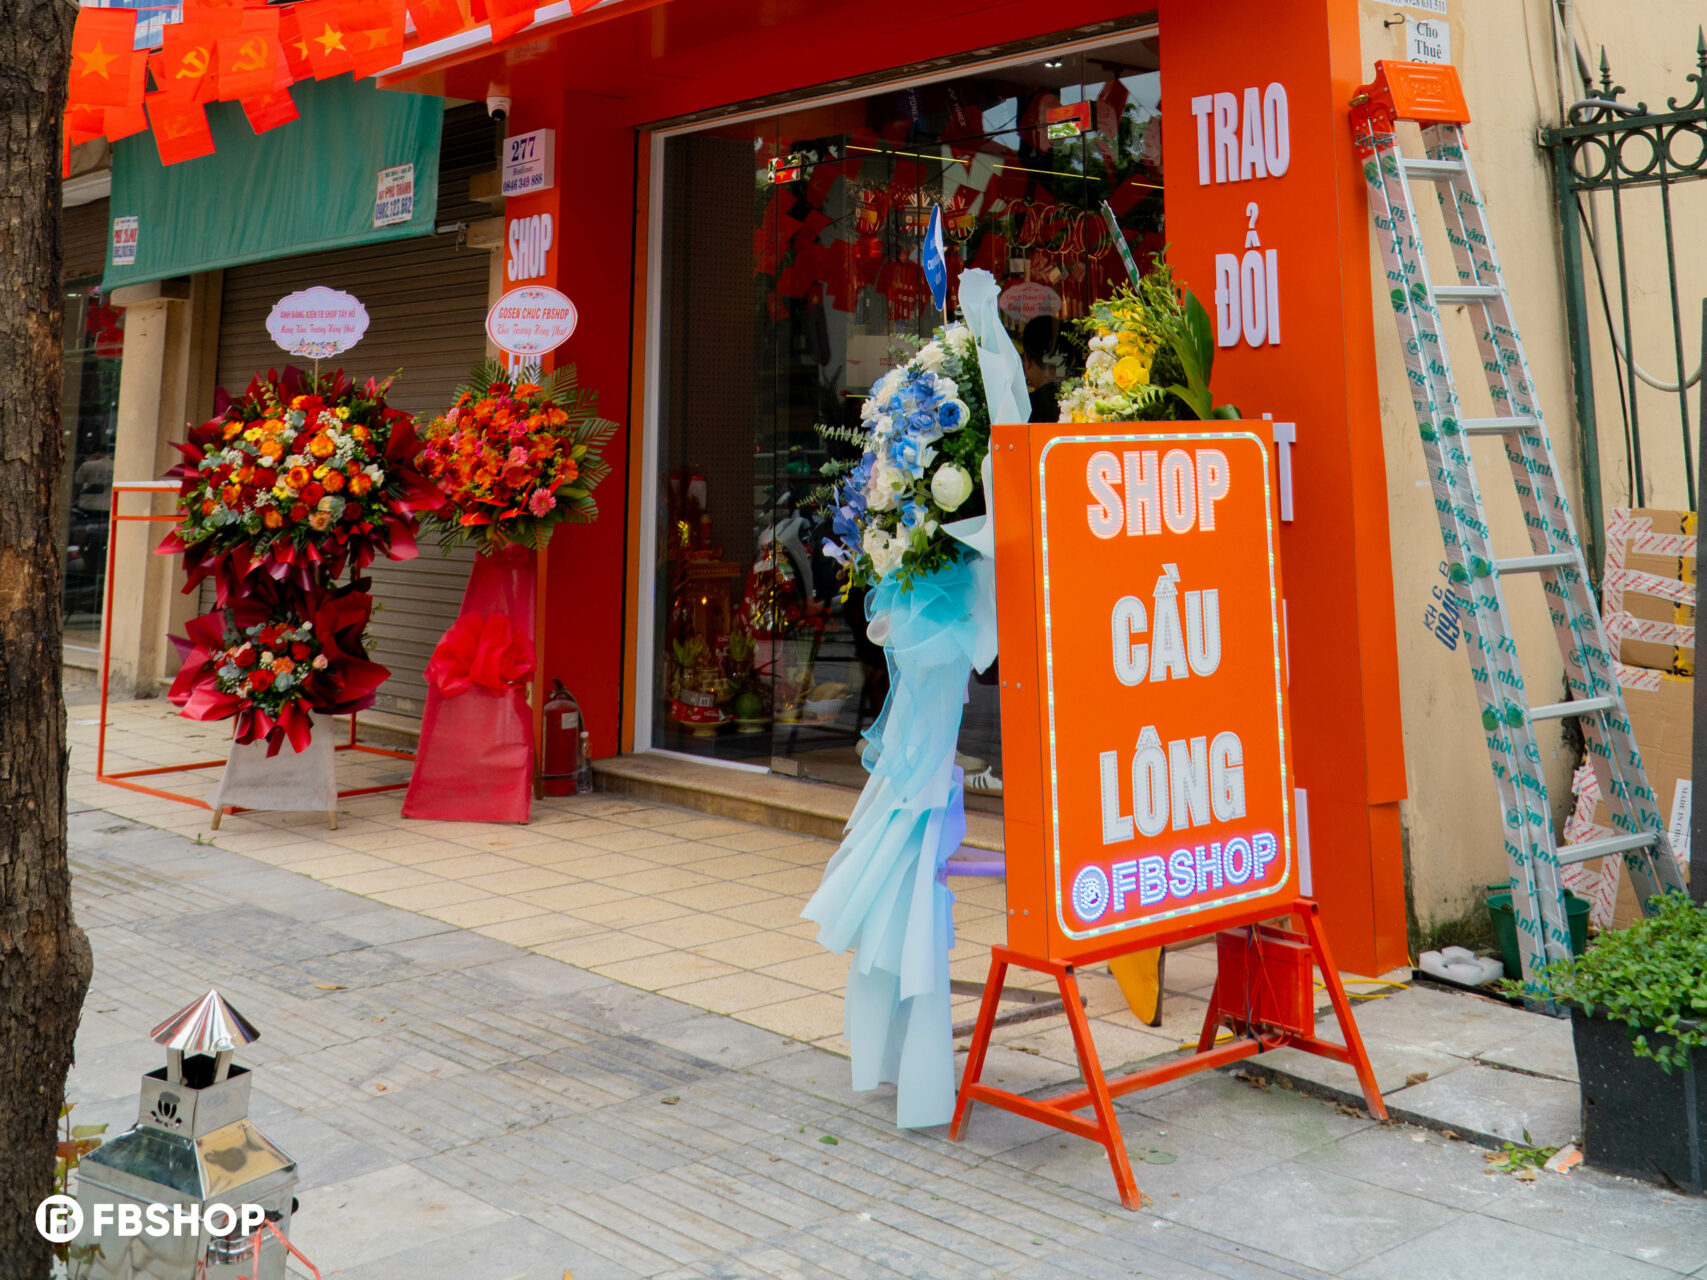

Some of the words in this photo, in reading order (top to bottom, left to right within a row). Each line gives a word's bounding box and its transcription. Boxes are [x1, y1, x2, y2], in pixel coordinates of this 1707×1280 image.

[1416, 21, 1438, 39] Cho
[1433, 0, 1446, 13] 511
[1414, 38, 1442, 60] Thuê
[511, 135, 537, 162] 277
[1191, 82, 1291, 187] TRAO
[508, 213, 553, 282] SHOP
[1214, 202, 1282, 348] ĐỔI
[499, 307, 521, 320] GOSEN
[521, 305, 541, 320] CHÚC
[542, 307, 570, 321] FBSHOP
[1085, 448, 1230, 540] SHOP
[1111, 563, 1222, 688] CẦU
[1100, 725, 1246, 845] LÔNG
[1111, 831, 1278, 913] FBSHOP
